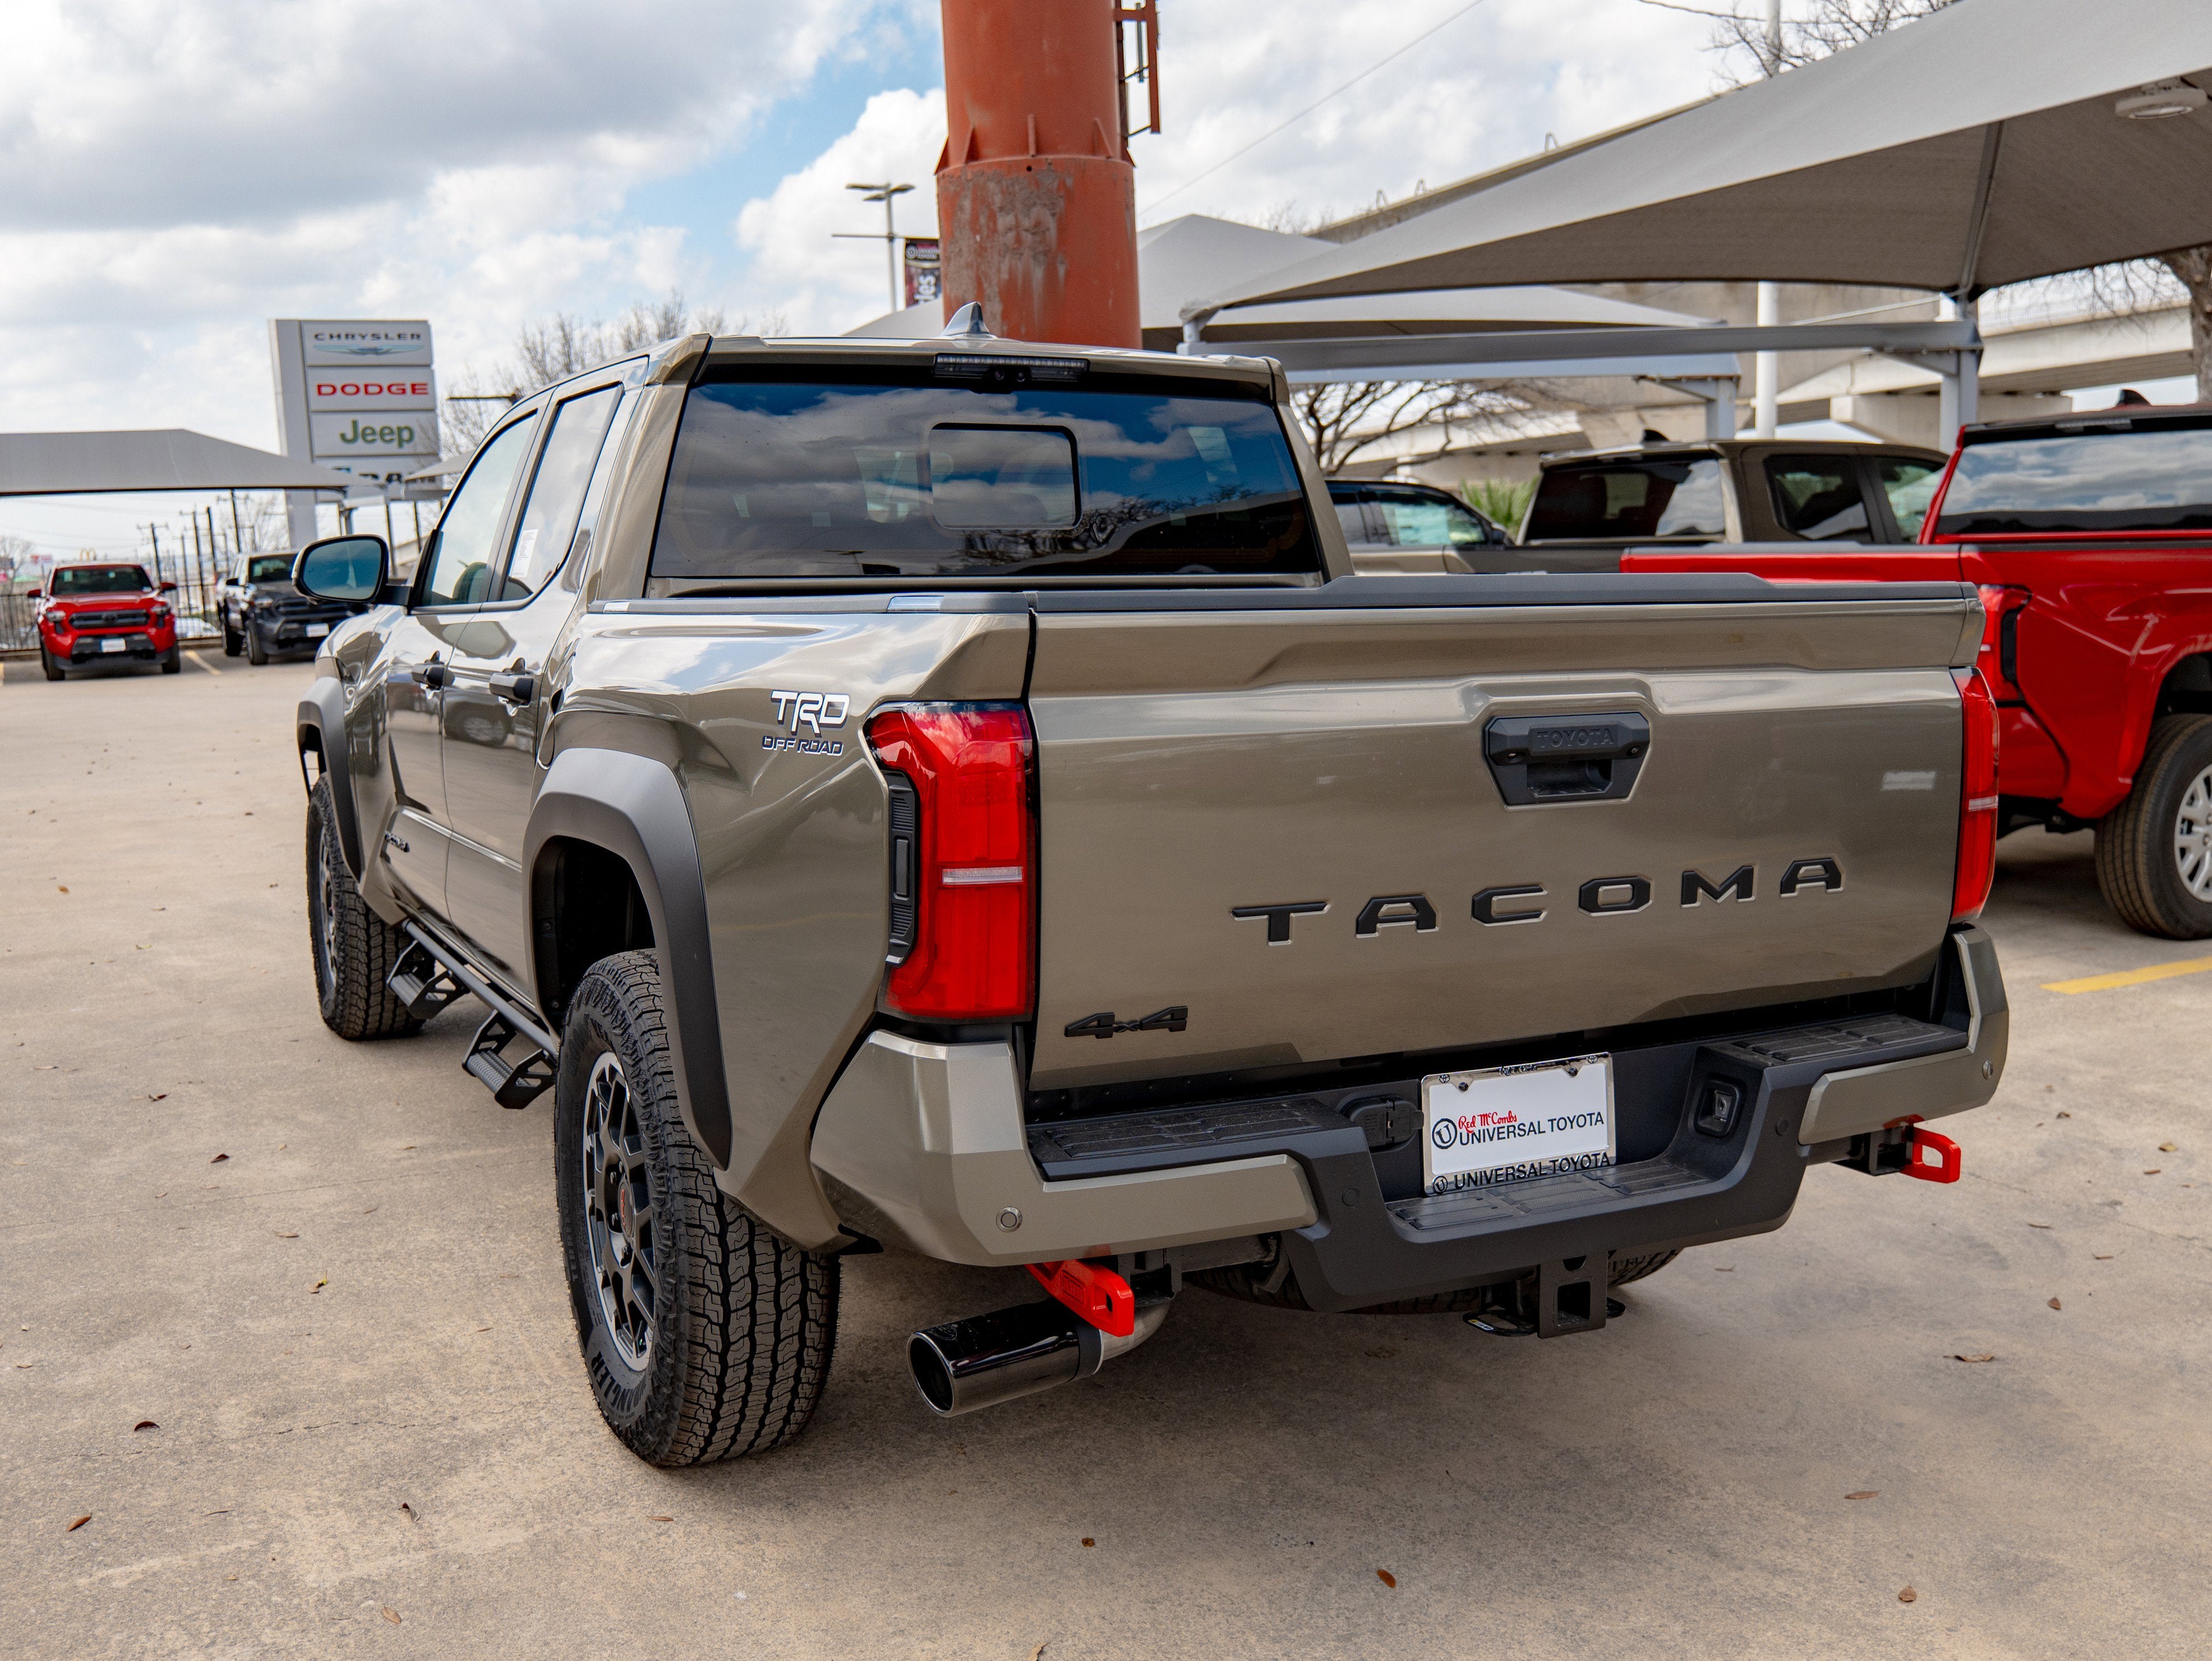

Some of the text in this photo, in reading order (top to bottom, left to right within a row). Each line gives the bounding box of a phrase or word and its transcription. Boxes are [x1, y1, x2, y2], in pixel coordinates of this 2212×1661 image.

[315, 332, 422, 340] CHRYSLER
[317, 383, 429, 396] DODGE
[340, 419, 414, 448] Jeep
[771, 690, 850, 738] TRD
[762, 736, 844, 756] OFF ROAD
[1537, 729, 1615, 748] TOYOTA
[1230, 857, 1844, 945] TACOMA
[1458, 1110, 1517, 1134] Red McCombs
[1459, 1120, 1546, 1146] UNIVERSAL
[1548, 1111, 1605, 1133] TOYOTA
[1453, 1162, 1548, 1190] UNIVERSAL
[1548, 1152, 1611, 1174] TOYOTA
